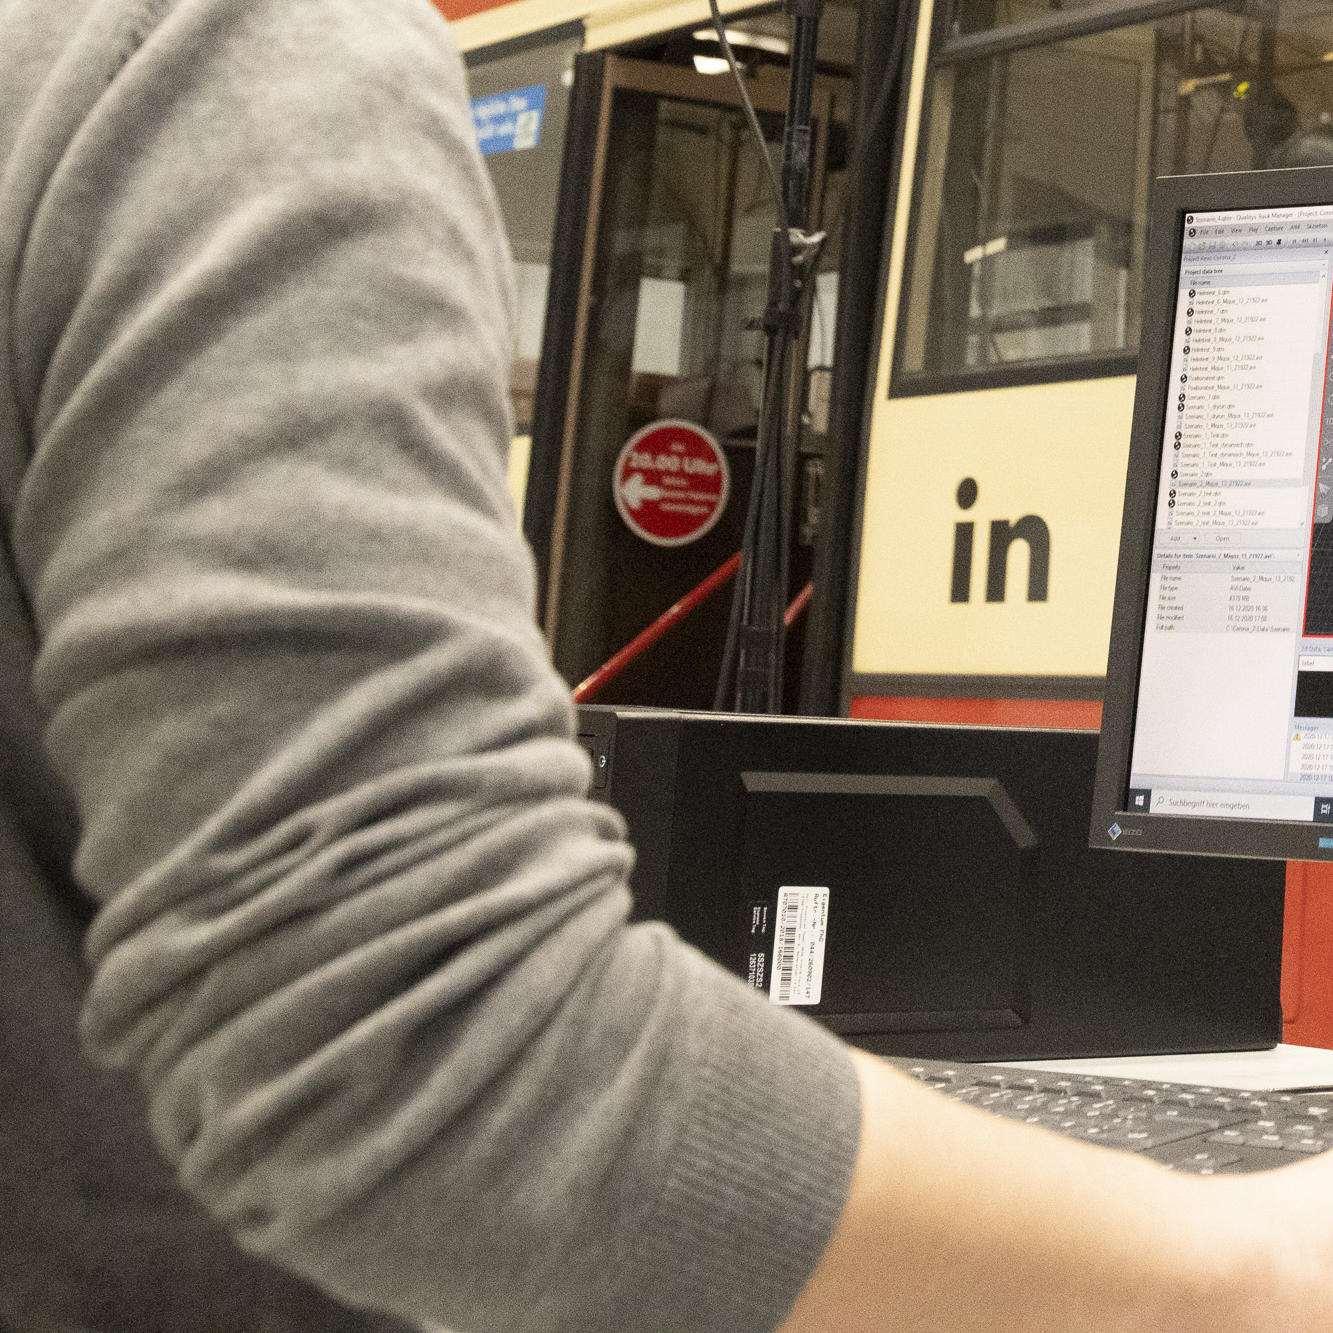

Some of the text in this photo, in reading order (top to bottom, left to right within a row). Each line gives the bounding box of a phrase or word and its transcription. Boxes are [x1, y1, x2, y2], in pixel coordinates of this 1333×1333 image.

[949, 477, 1051, 605] in
[1169, 798, 1205, 809] Suchbegriff
[1220, 802, 1250, 810] eingeben
